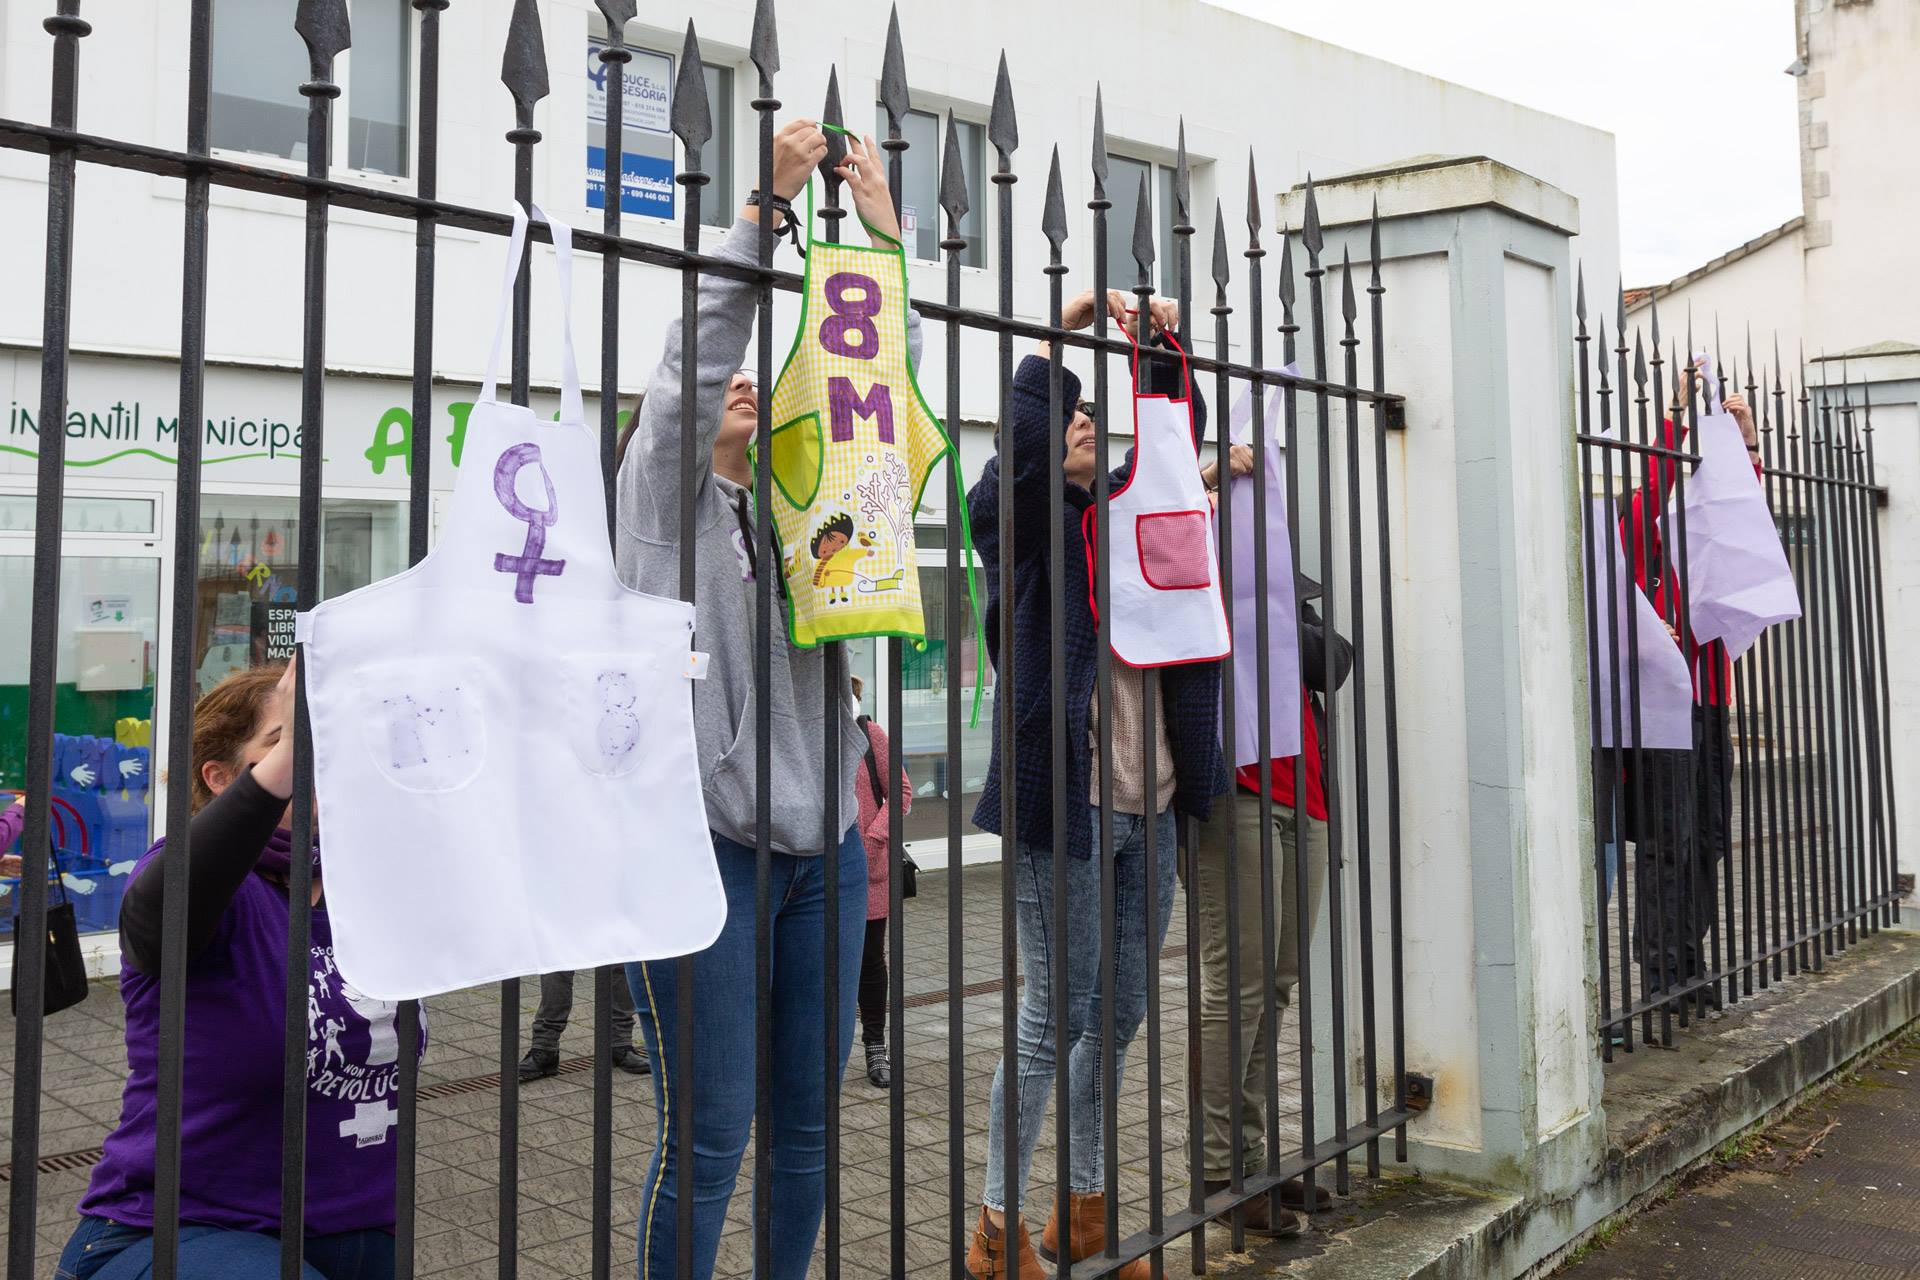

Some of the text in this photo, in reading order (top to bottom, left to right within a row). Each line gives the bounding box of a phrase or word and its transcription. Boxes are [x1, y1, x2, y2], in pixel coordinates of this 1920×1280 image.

[621, 73, 650, 88] DUCE
[622, 85, 667, 103] SESORIA
[819, 272, 882, 360] 8
[828, 377, 895, 445] M
[268, 634, 296, 646] VIOL
[343, 1064, 366, 1078] NON
[310, 1070, 399, 1101] REVOLUC
